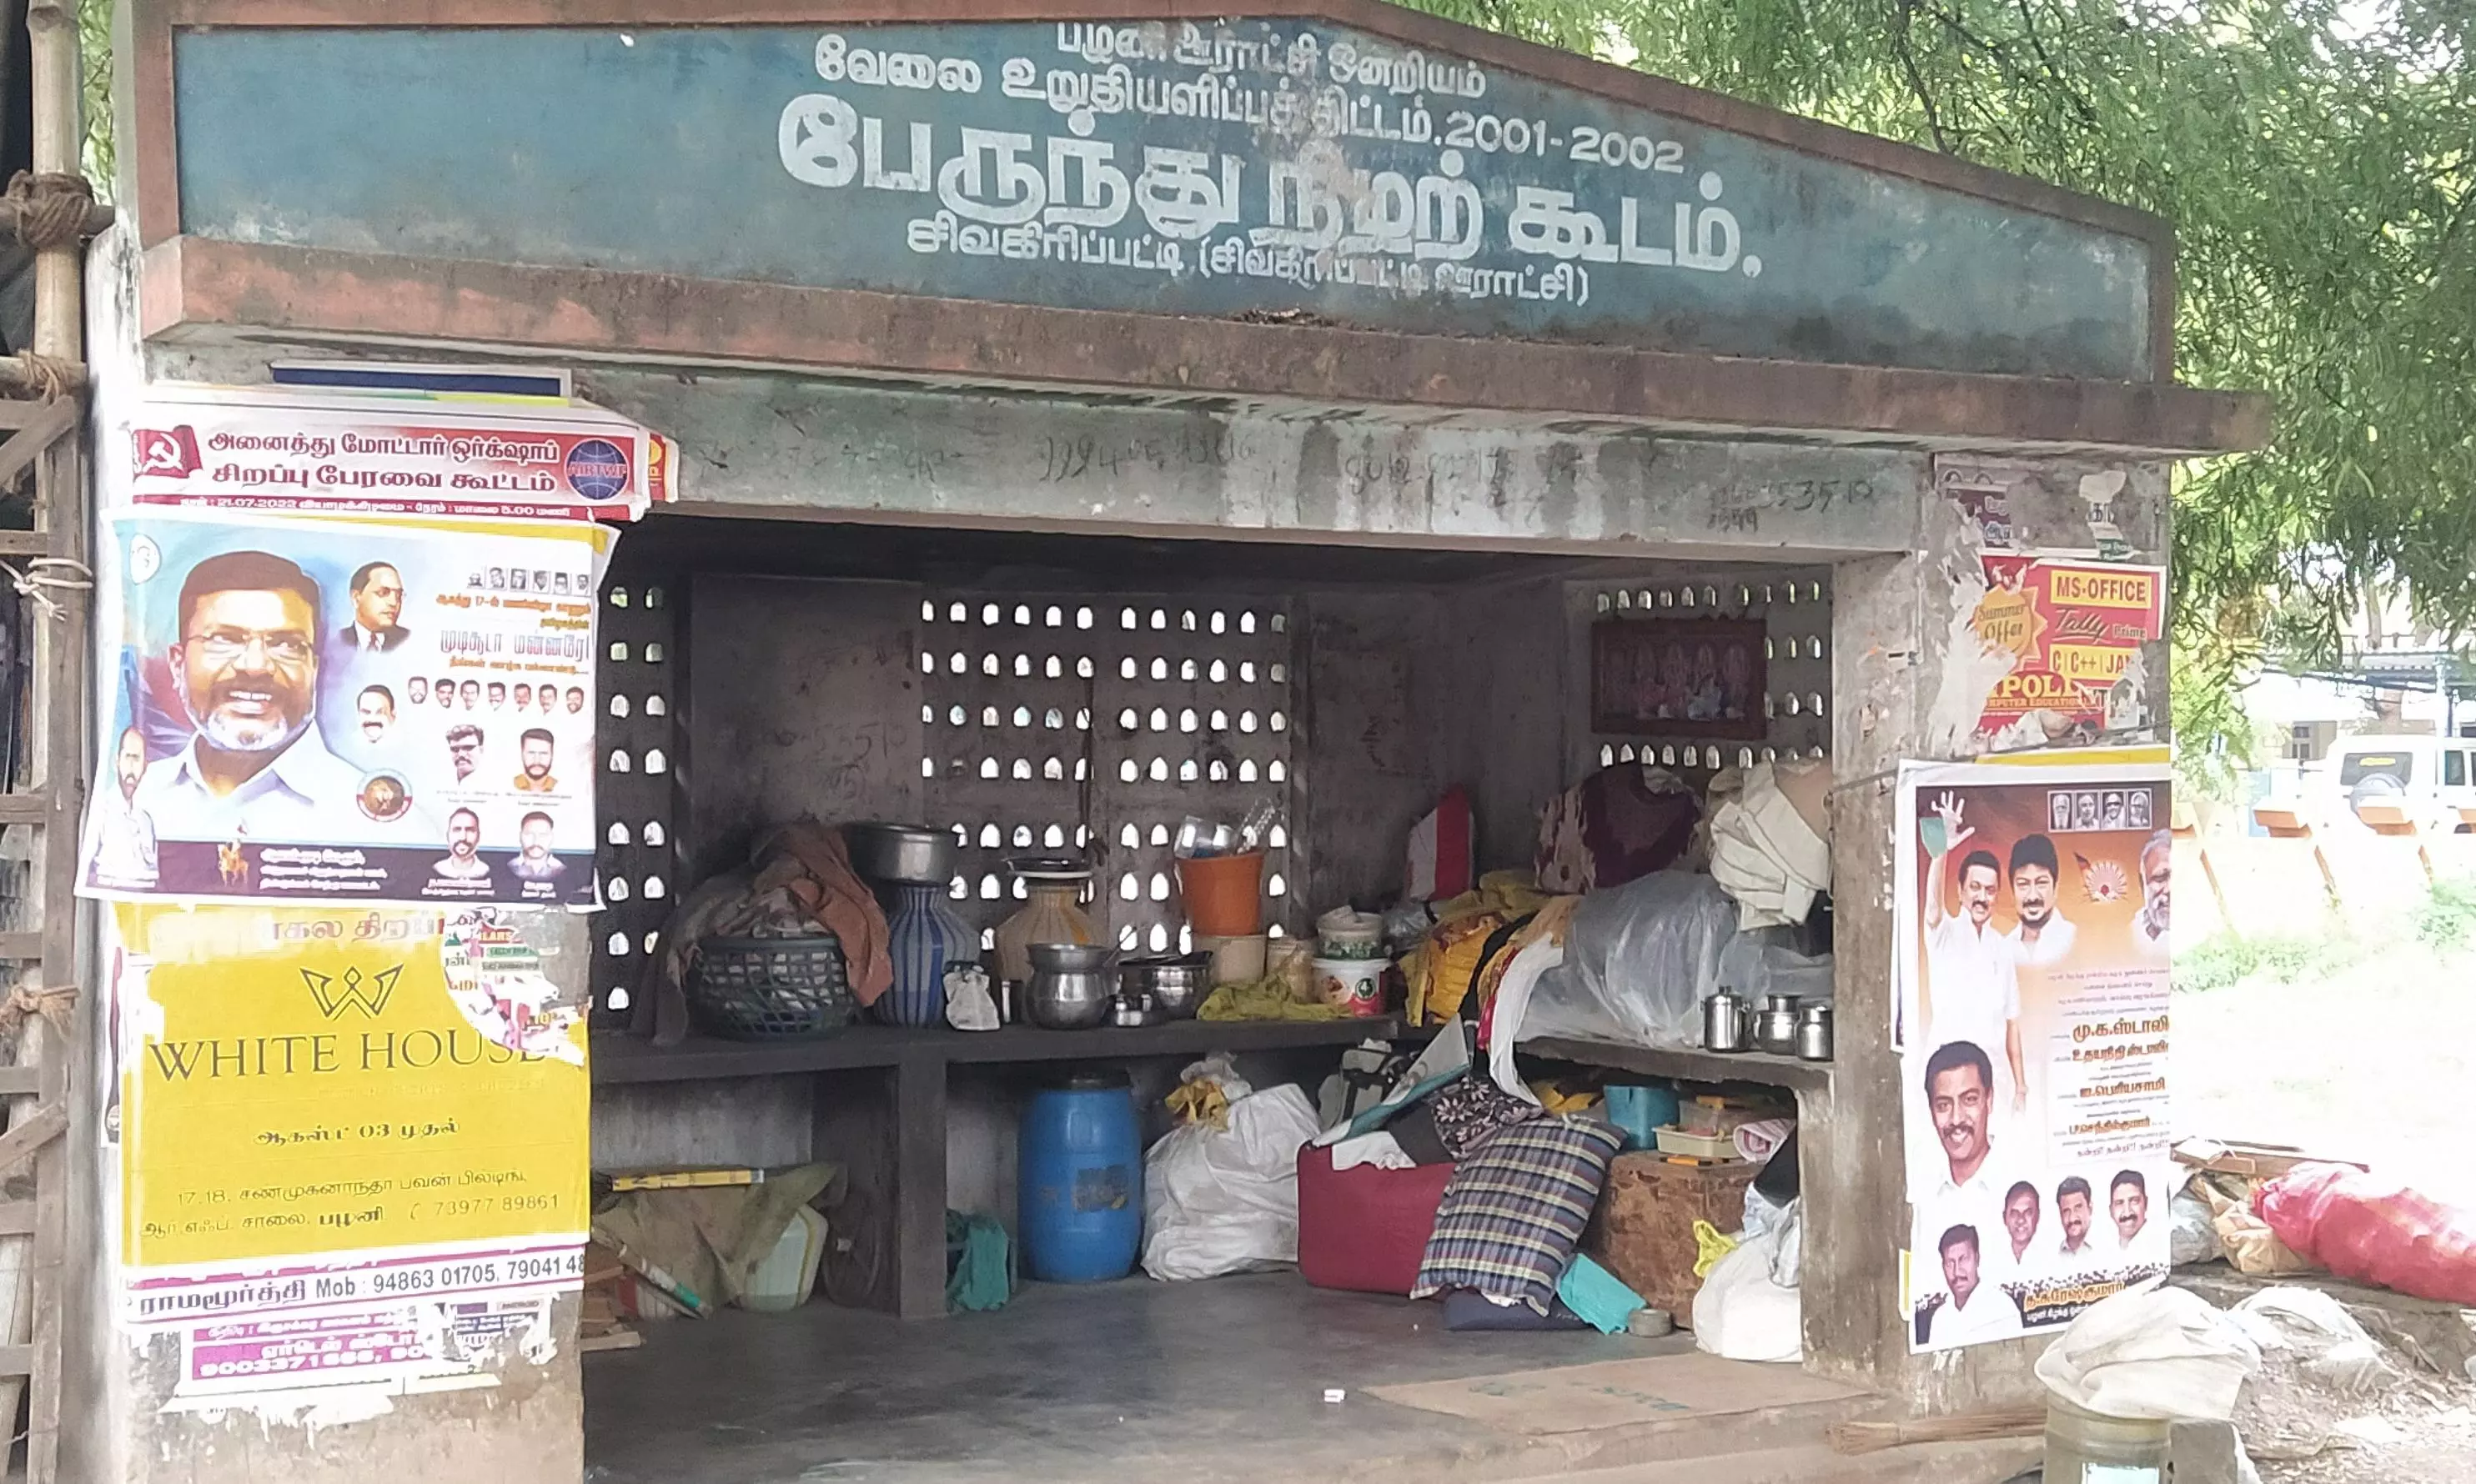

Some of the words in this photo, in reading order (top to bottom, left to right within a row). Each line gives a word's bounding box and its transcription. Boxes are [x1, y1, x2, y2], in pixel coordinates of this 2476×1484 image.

[815, 33, 983, 93] வேலை
[777, 93, 1245, 240] பேருந்து
[208, 431, 336, 459] அனைத்து
[340, 432, 446, 457] மோட்டார்
[212, 463, 309, 489] சிறப்பு
[315, 464, 442, 489] பேரவை
[449, 472, 556, 492] கூட்டம்
[1983, 621, 2025, 644] Offer
[2055, 607, 2110, 644] Tally
[148, 1033, 341, 1082] WHITE
[359, 1123, 391, 1138] 03
[398, 1116, 460, 1140] முதல்
[434, 1197, 495, 1217] 73977
[501, 1193, 560, 1211] 89861
[374, 1268, 434, 1294] 94863
[507, 1256, 561, 1281] 79041
